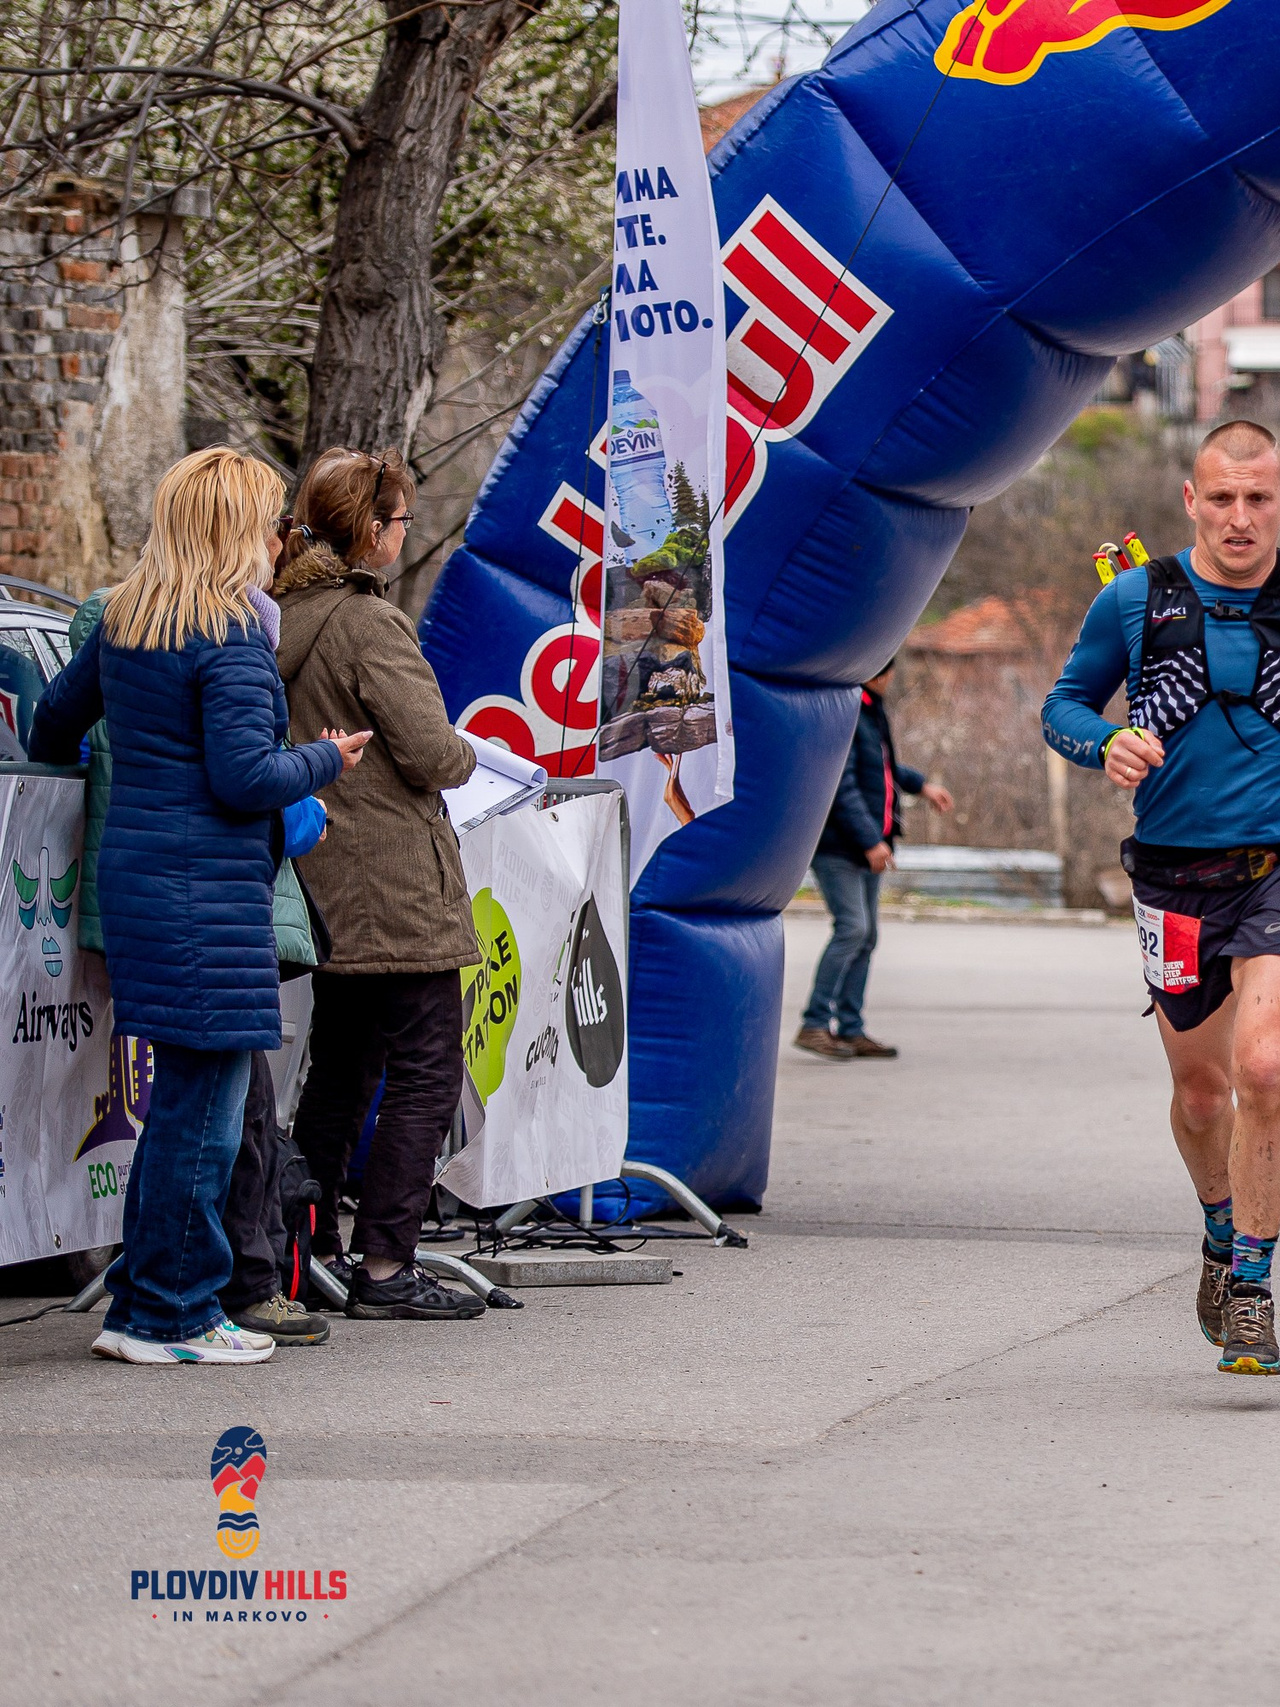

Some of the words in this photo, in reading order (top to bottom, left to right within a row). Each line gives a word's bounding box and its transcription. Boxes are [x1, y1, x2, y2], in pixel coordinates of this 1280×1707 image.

[615, 213, 667, 251] ТЕ.
[1152, 606, 1187, 619] LEKI
[12, 990, 94, 1052] Airways
[87, 1161, 118, 1199] ECO
